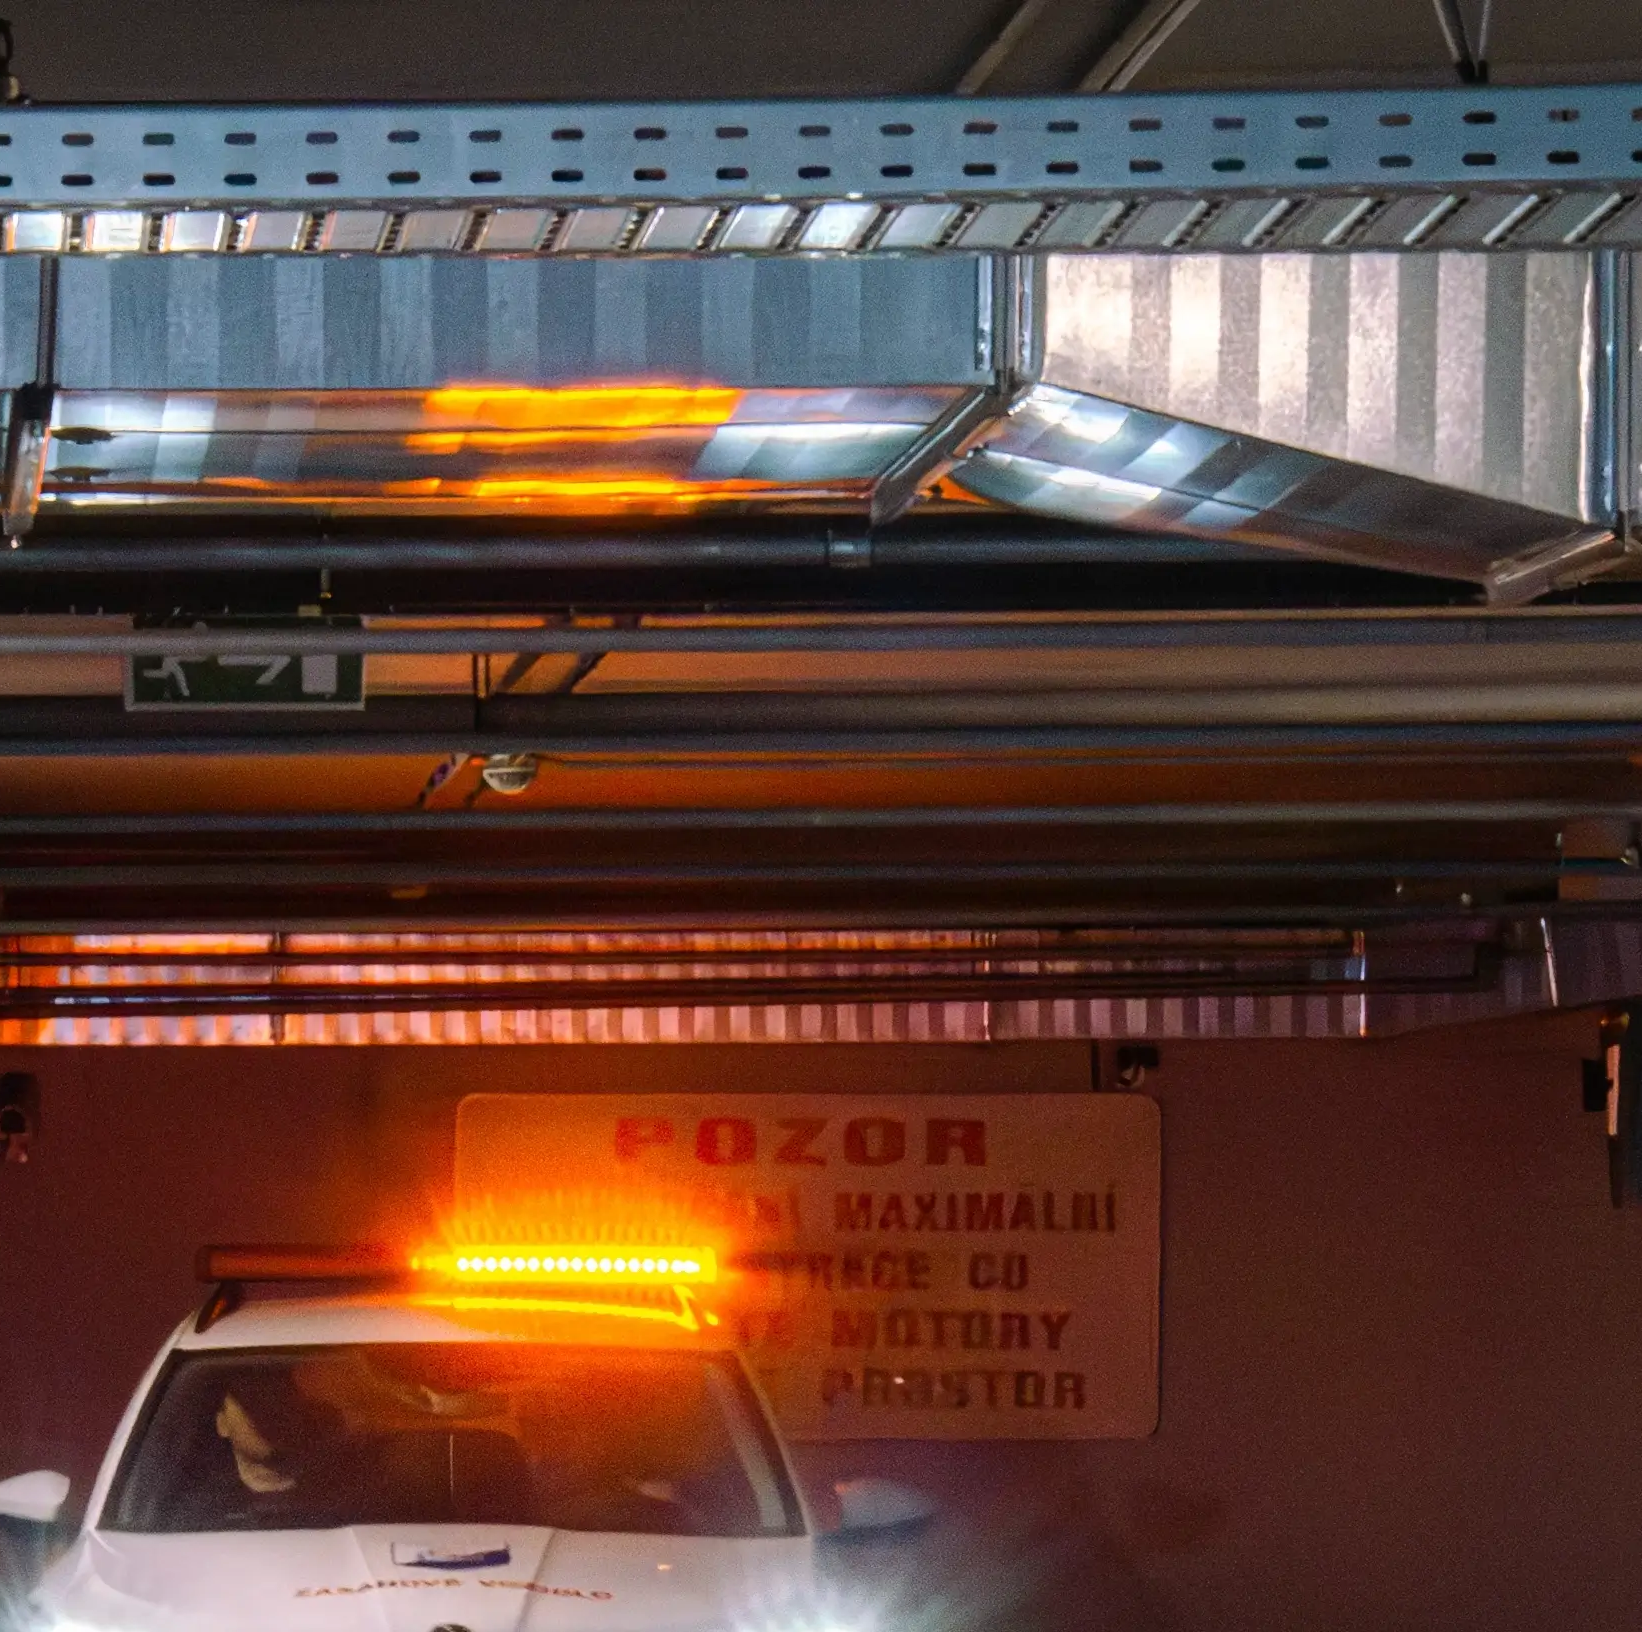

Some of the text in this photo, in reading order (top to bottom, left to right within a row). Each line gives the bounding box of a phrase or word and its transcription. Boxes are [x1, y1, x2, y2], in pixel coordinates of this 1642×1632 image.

[613, 1116, 988, 1168] POZOR
[967, 1252, 1029, 1292] CO
[831, 1310, 1072, 1351] MOTORY
[822, 1369, 1087, 1411] PROSTOR
